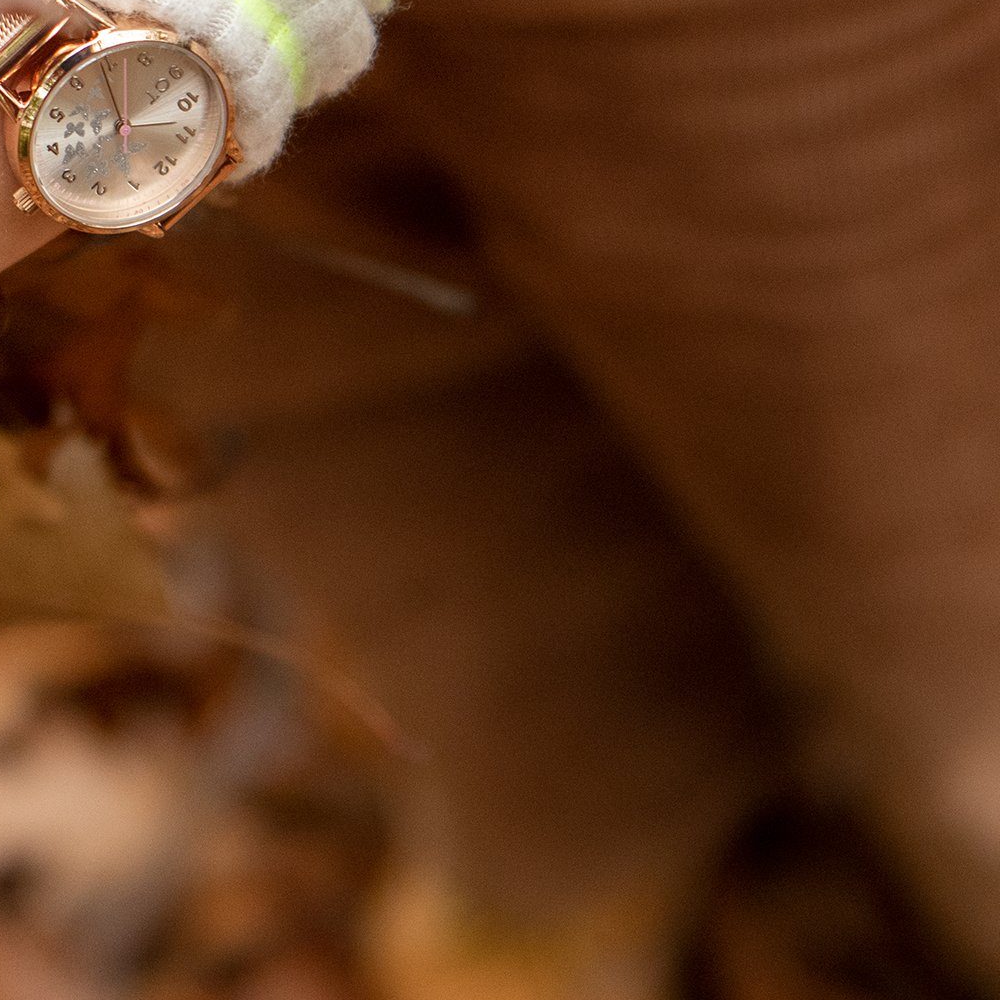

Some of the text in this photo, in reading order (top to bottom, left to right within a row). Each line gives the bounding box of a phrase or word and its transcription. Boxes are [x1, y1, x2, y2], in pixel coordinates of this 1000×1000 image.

[177, 92, 199, 112] 10
[49, 106, 65, 123] 5
[175, 126, 196, 144] 11
[46, 142, 59, 156] 4
[153, 156, 177, 176] 12
[62, 168, 76, 183] 3
[91, 181, 106, 196] 2
[127, 181, 140, 192] 1
